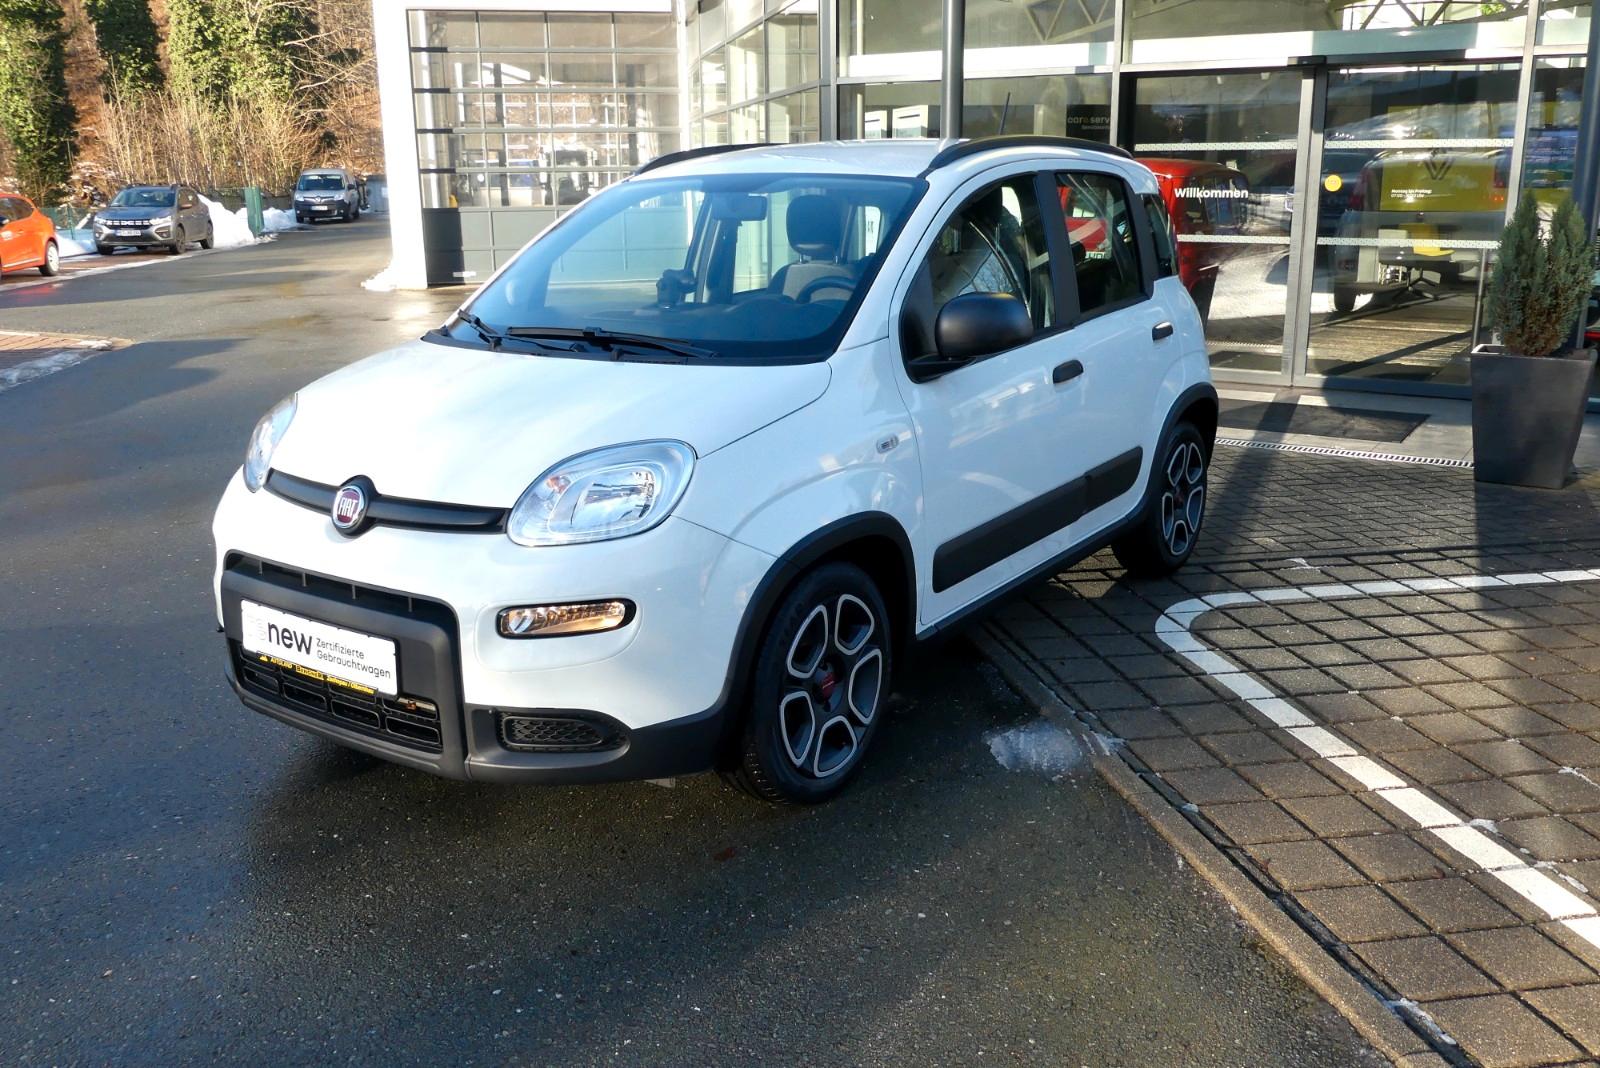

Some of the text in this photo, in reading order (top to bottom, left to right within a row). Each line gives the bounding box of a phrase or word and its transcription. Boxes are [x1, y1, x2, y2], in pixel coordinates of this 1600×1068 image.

[1173, 186, 1249, 199] Willkommen
[338, 496, 359, 518] FIAT
[316, 637, 365, 660] Zertifizierte
[316, 650, 391, 679] Gebrauchtwagen
